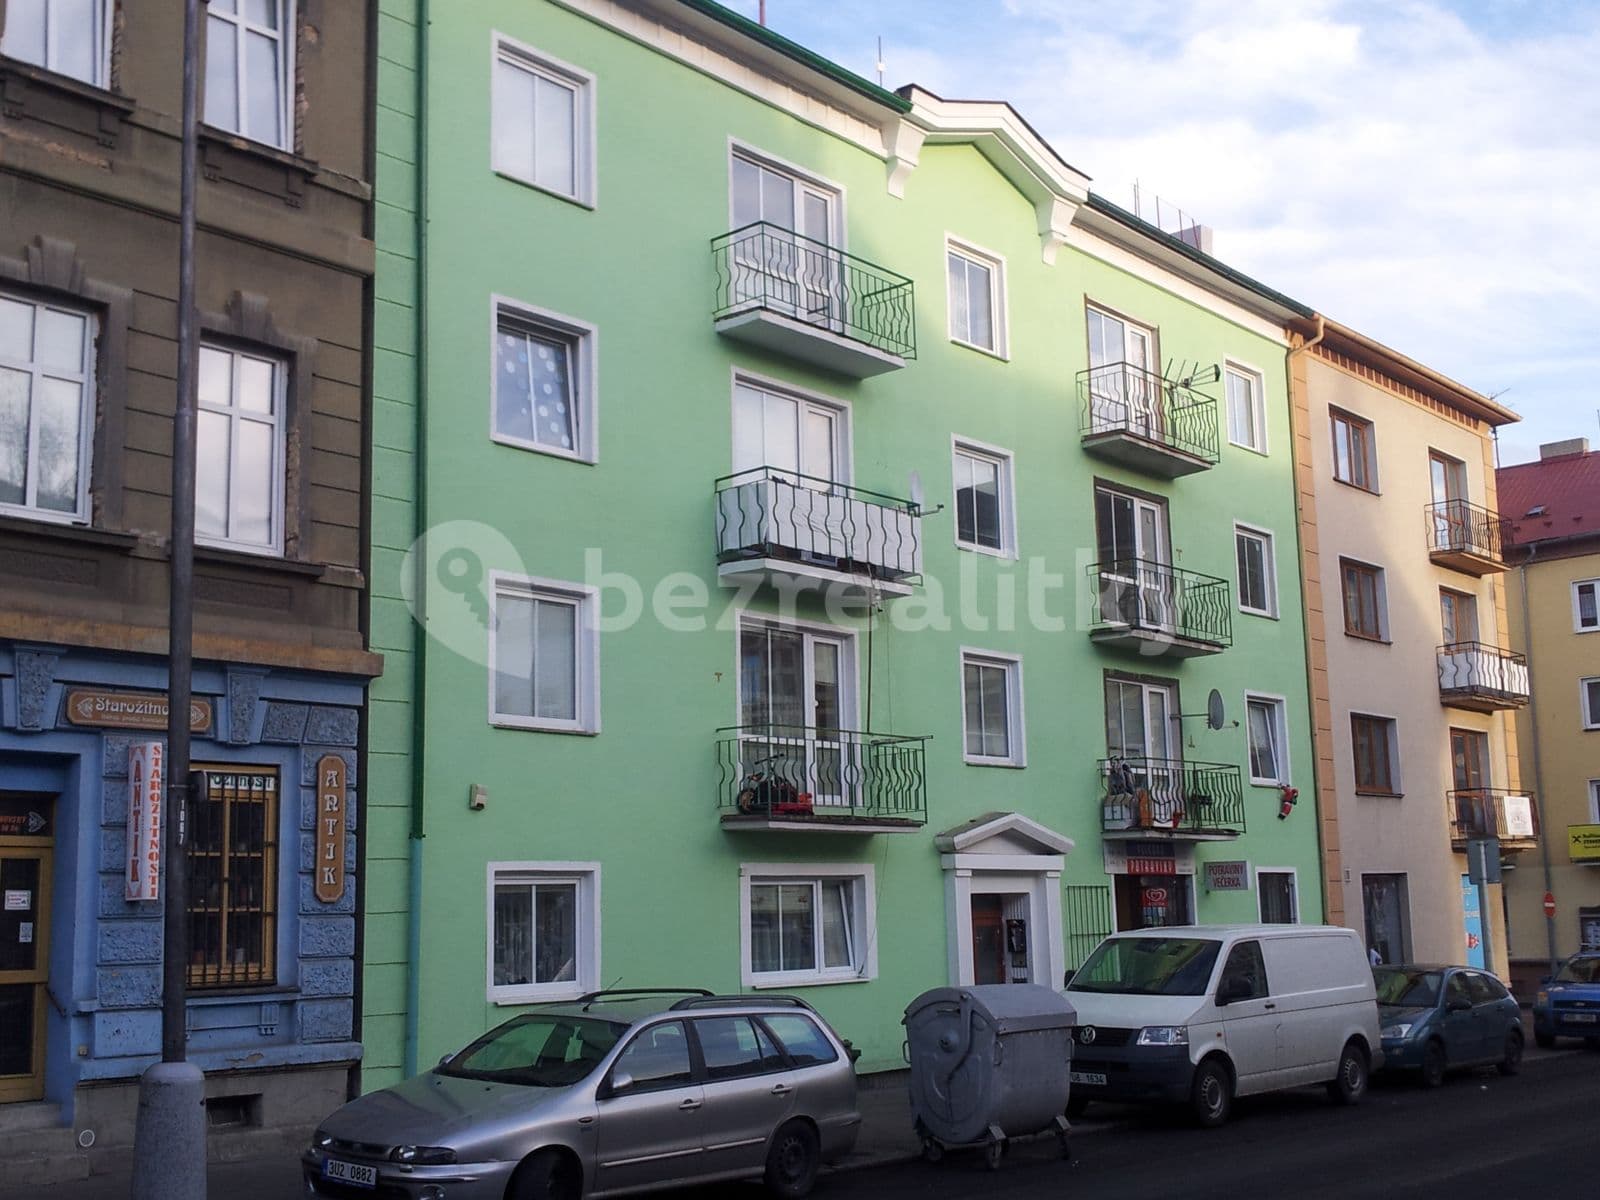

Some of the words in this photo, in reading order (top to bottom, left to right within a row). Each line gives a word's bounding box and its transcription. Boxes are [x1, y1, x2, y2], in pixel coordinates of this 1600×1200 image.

[130, 759, 142, 882] ANTIK
[1207, 864, 1244, 877] POTRAVINY
[350, 1165, 372, 1183] 0882
